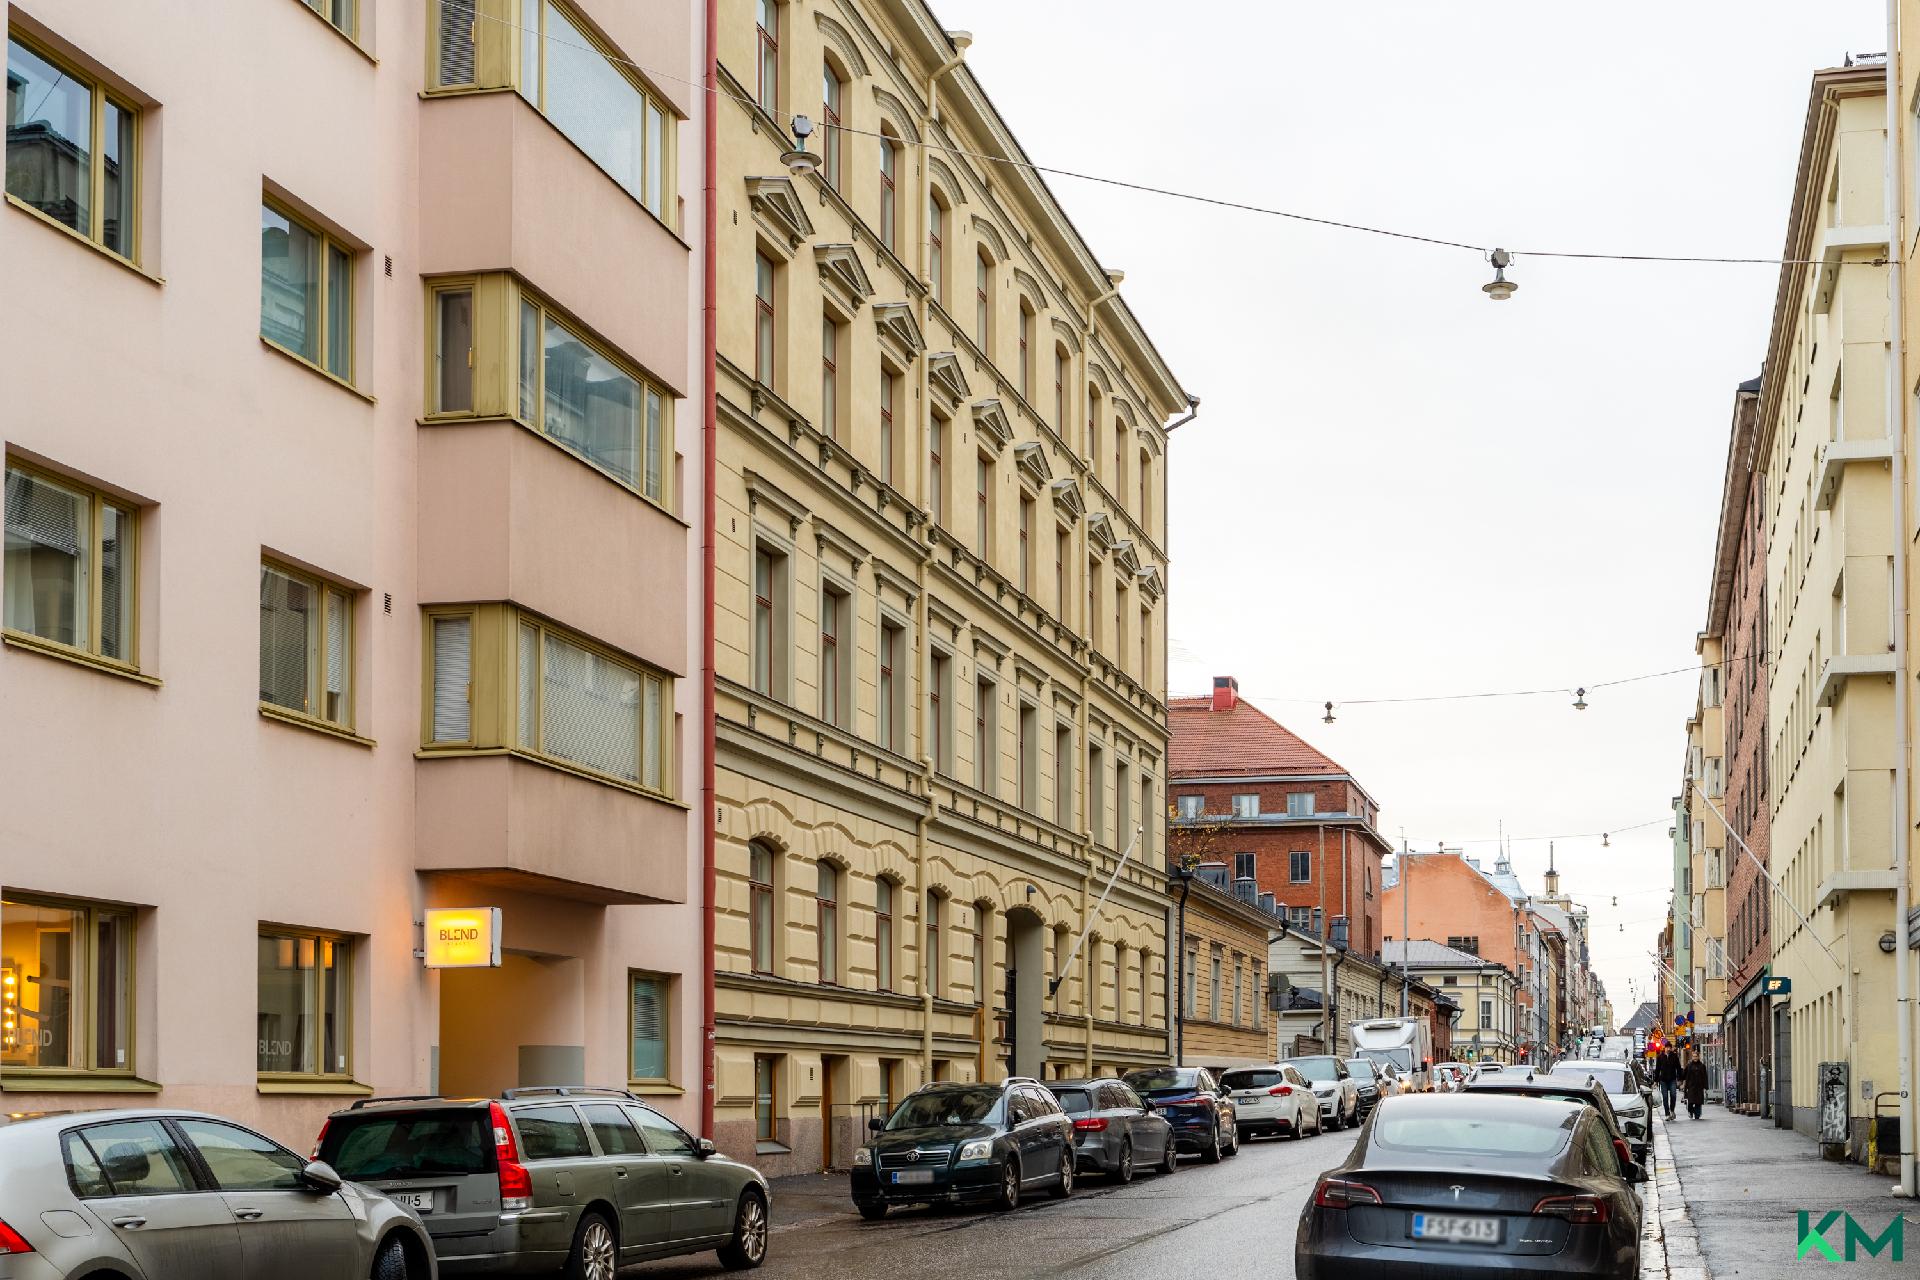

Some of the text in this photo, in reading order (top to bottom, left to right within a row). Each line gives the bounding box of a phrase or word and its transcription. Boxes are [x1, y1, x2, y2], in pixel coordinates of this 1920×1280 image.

[439, 928, 479, 941] BLEND
[1767, 979, 1782, 991] EF
[258, 1039, 292, 1056] BLEND
